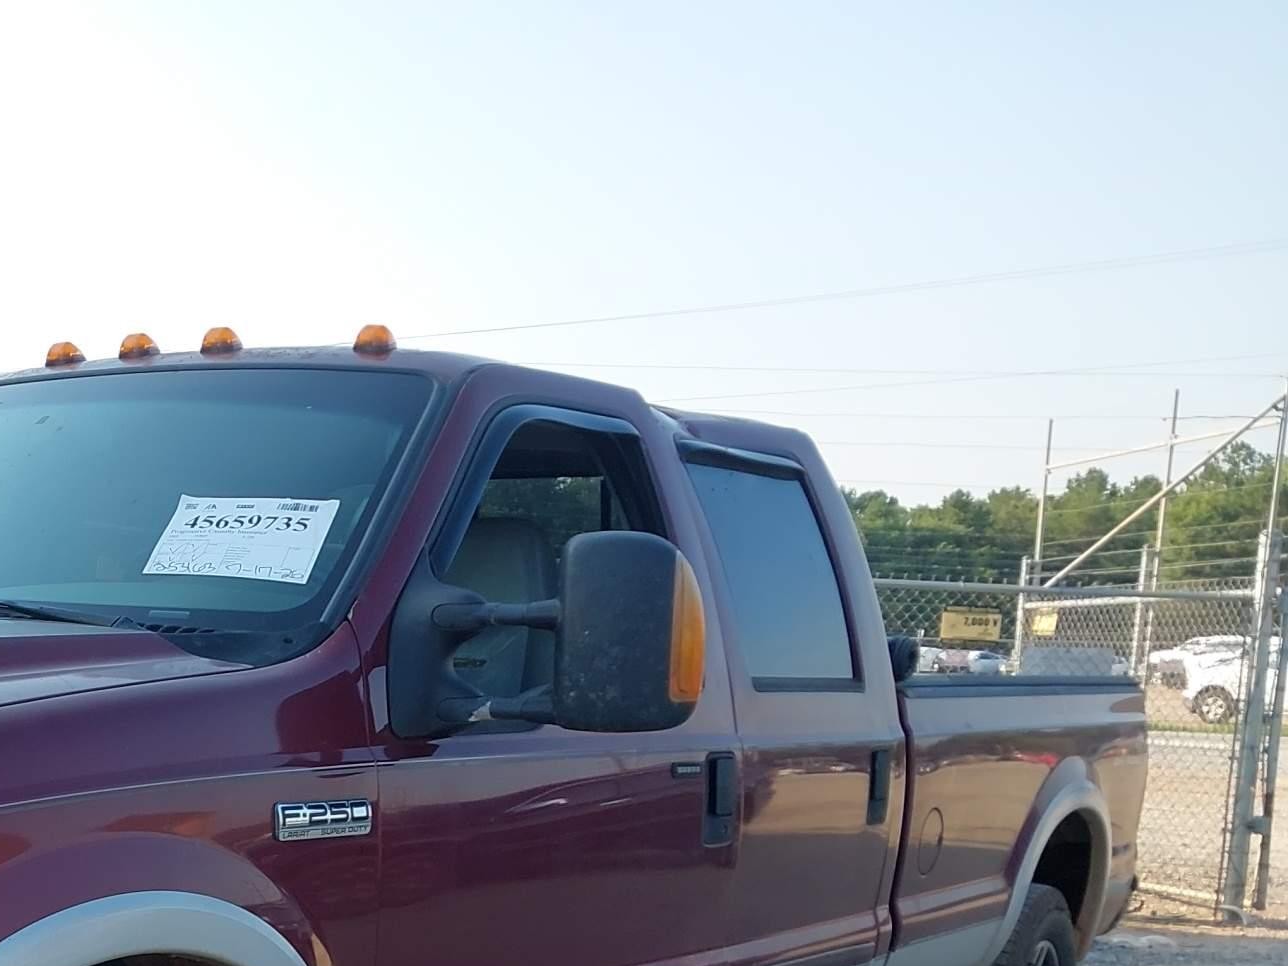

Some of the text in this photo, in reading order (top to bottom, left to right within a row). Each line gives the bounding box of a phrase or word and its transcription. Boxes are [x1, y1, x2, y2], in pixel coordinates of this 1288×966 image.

[183, 514, 311, 532] 45659735
[320, 826, 347, 836] SUPER
[347, 824, 369, 834] DUTY
